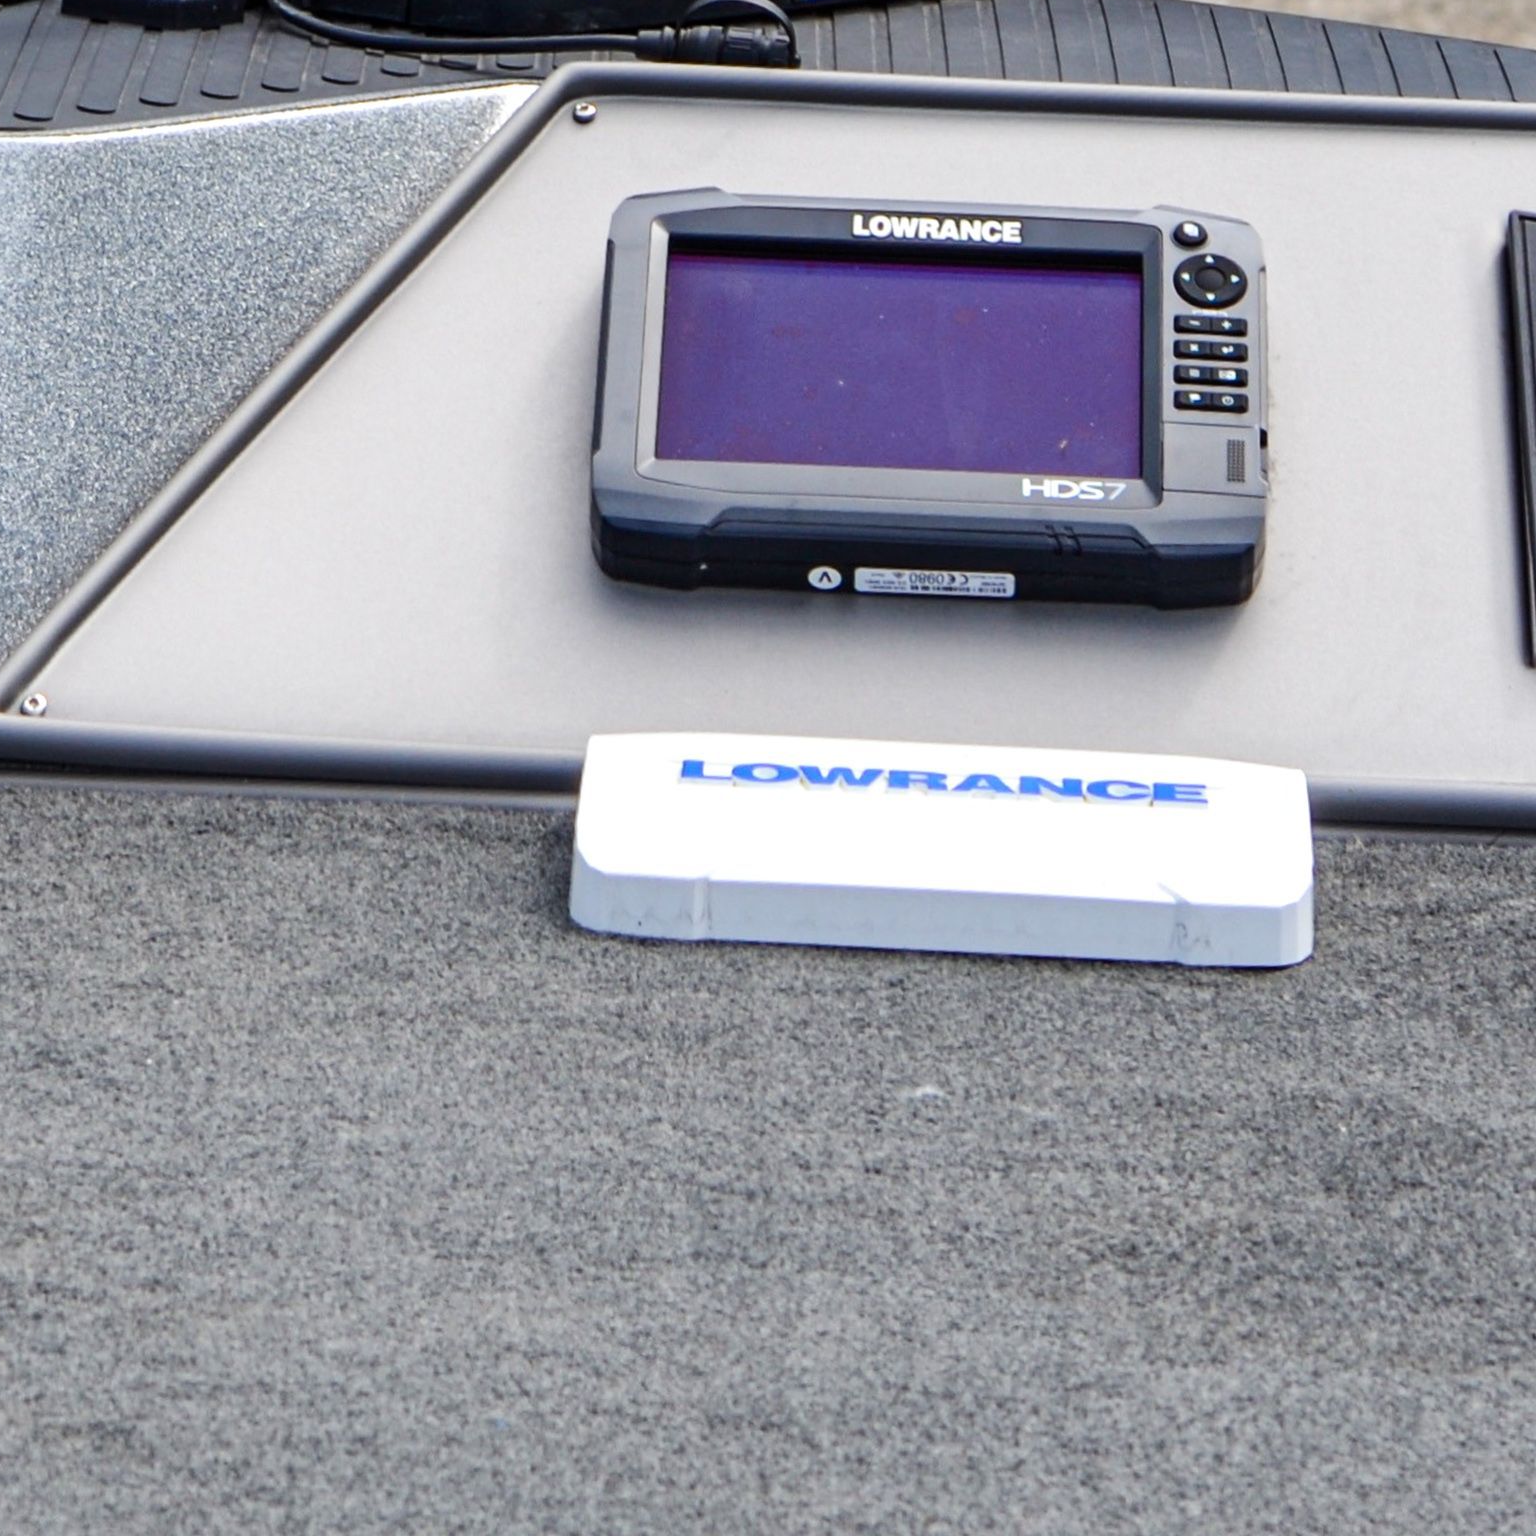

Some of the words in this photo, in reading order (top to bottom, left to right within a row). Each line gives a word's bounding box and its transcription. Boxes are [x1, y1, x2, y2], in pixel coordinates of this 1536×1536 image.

[852, 214, 1022, 243] LOWRANCE
[1022, 478, 1126, 501] HDS7
[679, 759, 1209, 806] LOWRANCE
